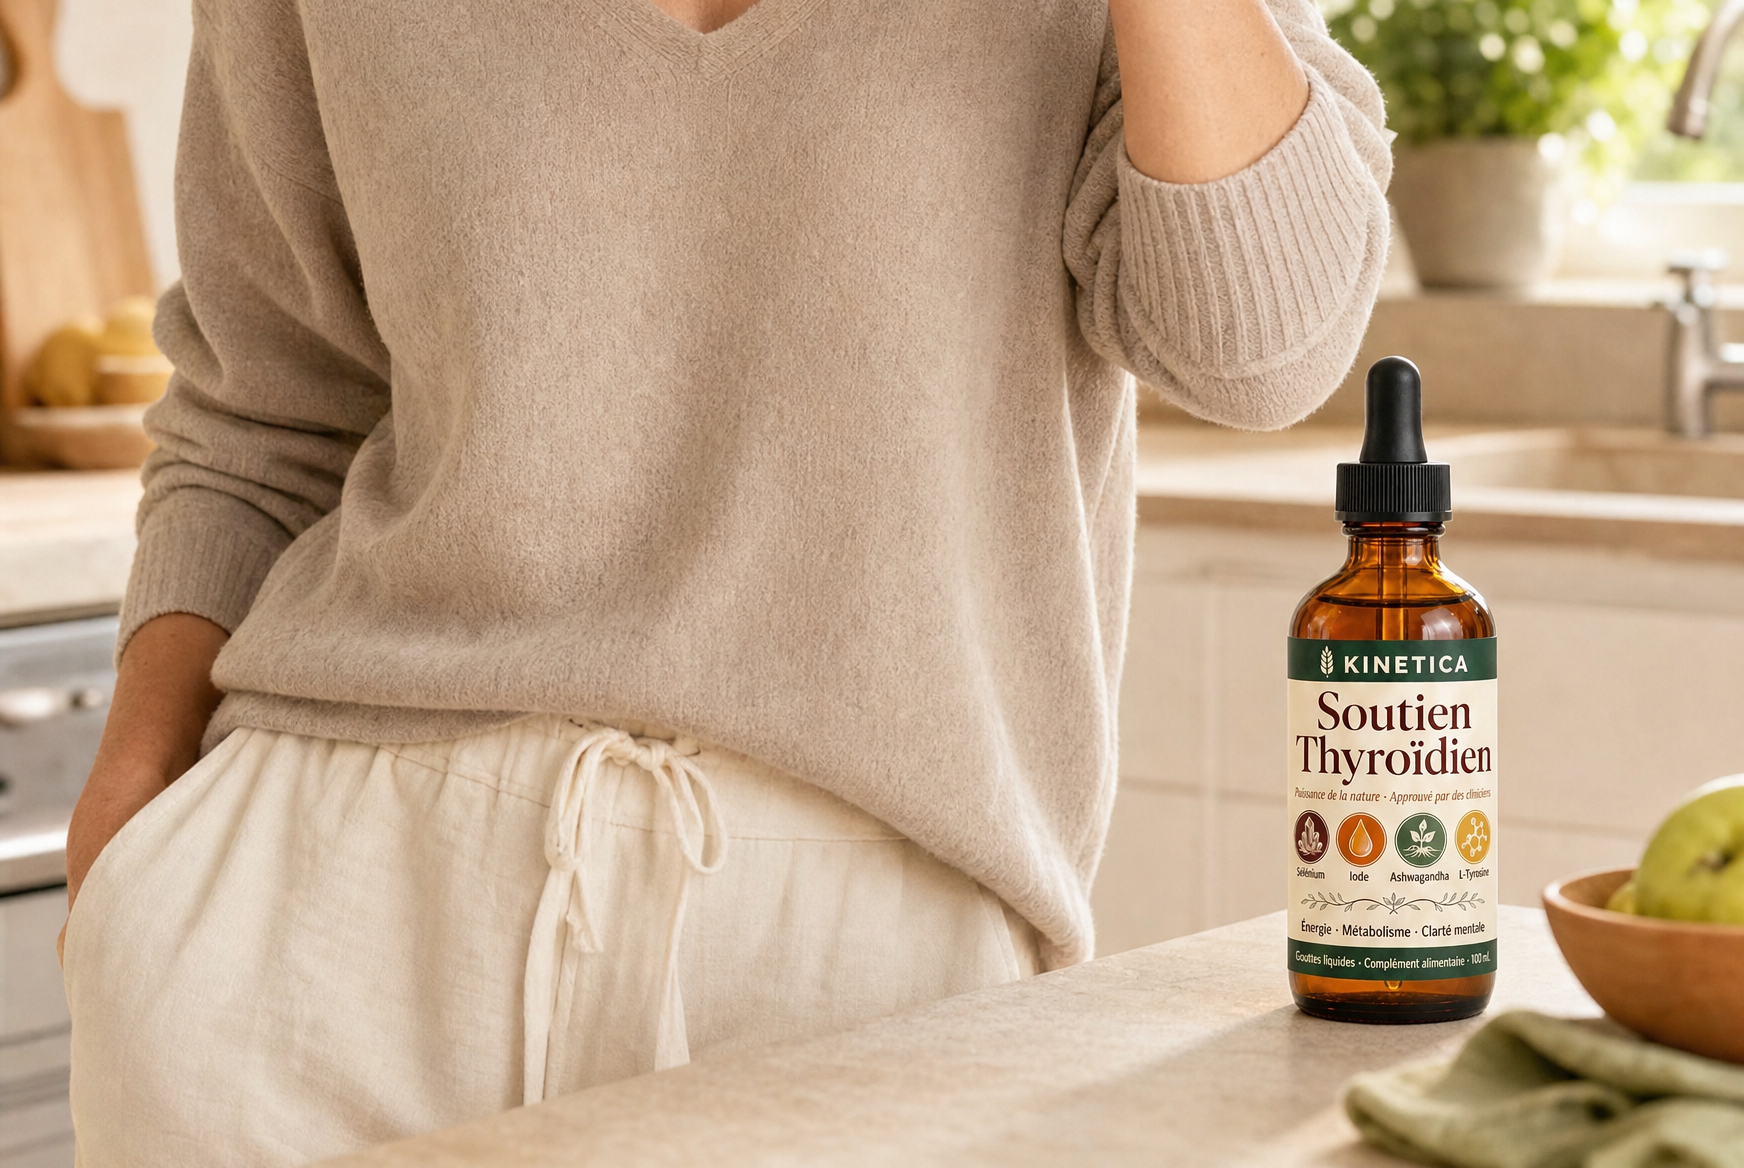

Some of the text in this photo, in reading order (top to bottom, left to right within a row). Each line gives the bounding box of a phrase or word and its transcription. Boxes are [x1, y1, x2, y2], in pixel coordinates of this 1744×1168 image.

[1344, 655, 1468, 674] KINETICA
[1317, 690, 1472, 732] Soutien
[1295, 735, 1492, 786] Thyroïdien
[1327, 789, 1337, 801] de
[1339, 790, 1348, 801] la
[1350, 792, 1380, 802] nature
[1389, 790, 1433, 805] Approuvé
[1434, 792, 1450, 805] par
[1451, 789, 1464, 801] des
[1349, 871, 1369, 882] Iode
[1390, 870, 1450, 885] Ashwagandha
[1301, 918, 1485, 938] Énergie Métabolisme Clarté mentale
[1323, 954, 1356, 969] liquides
[1364, 957, 1420, 971] Complément
[1421, 955, 1465, 969] alimentaire
[1471, 952, 1482, 964] 100
